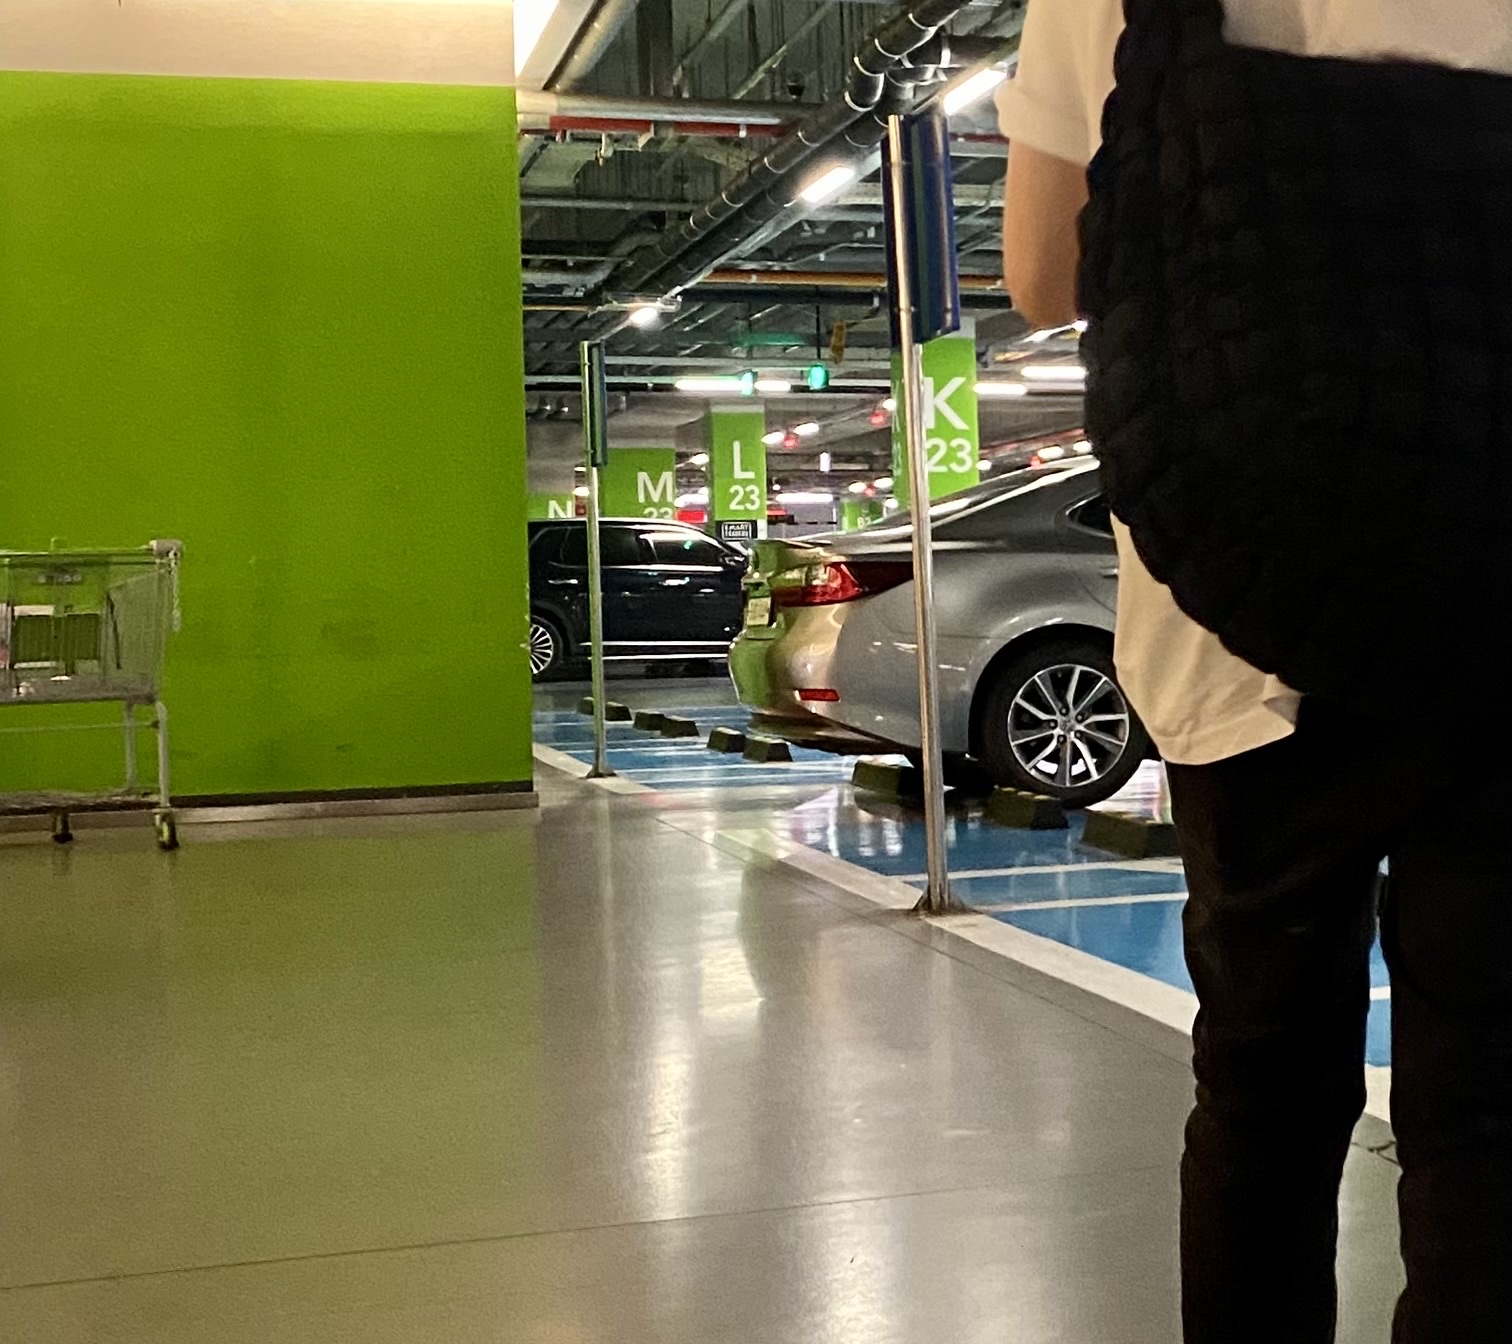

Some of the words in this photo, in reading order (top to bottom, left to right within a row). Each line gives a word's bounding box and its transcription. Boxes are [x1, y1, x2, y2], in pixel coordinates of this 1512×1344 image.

[923, 376, 970, 431] K
[732, 440, 756, 480] L
[925, 437, 973, 473] 23
[636, 471, 674, 504] M
[728, 484, 761, 511] 23
[547, 500, 572, 519] N
